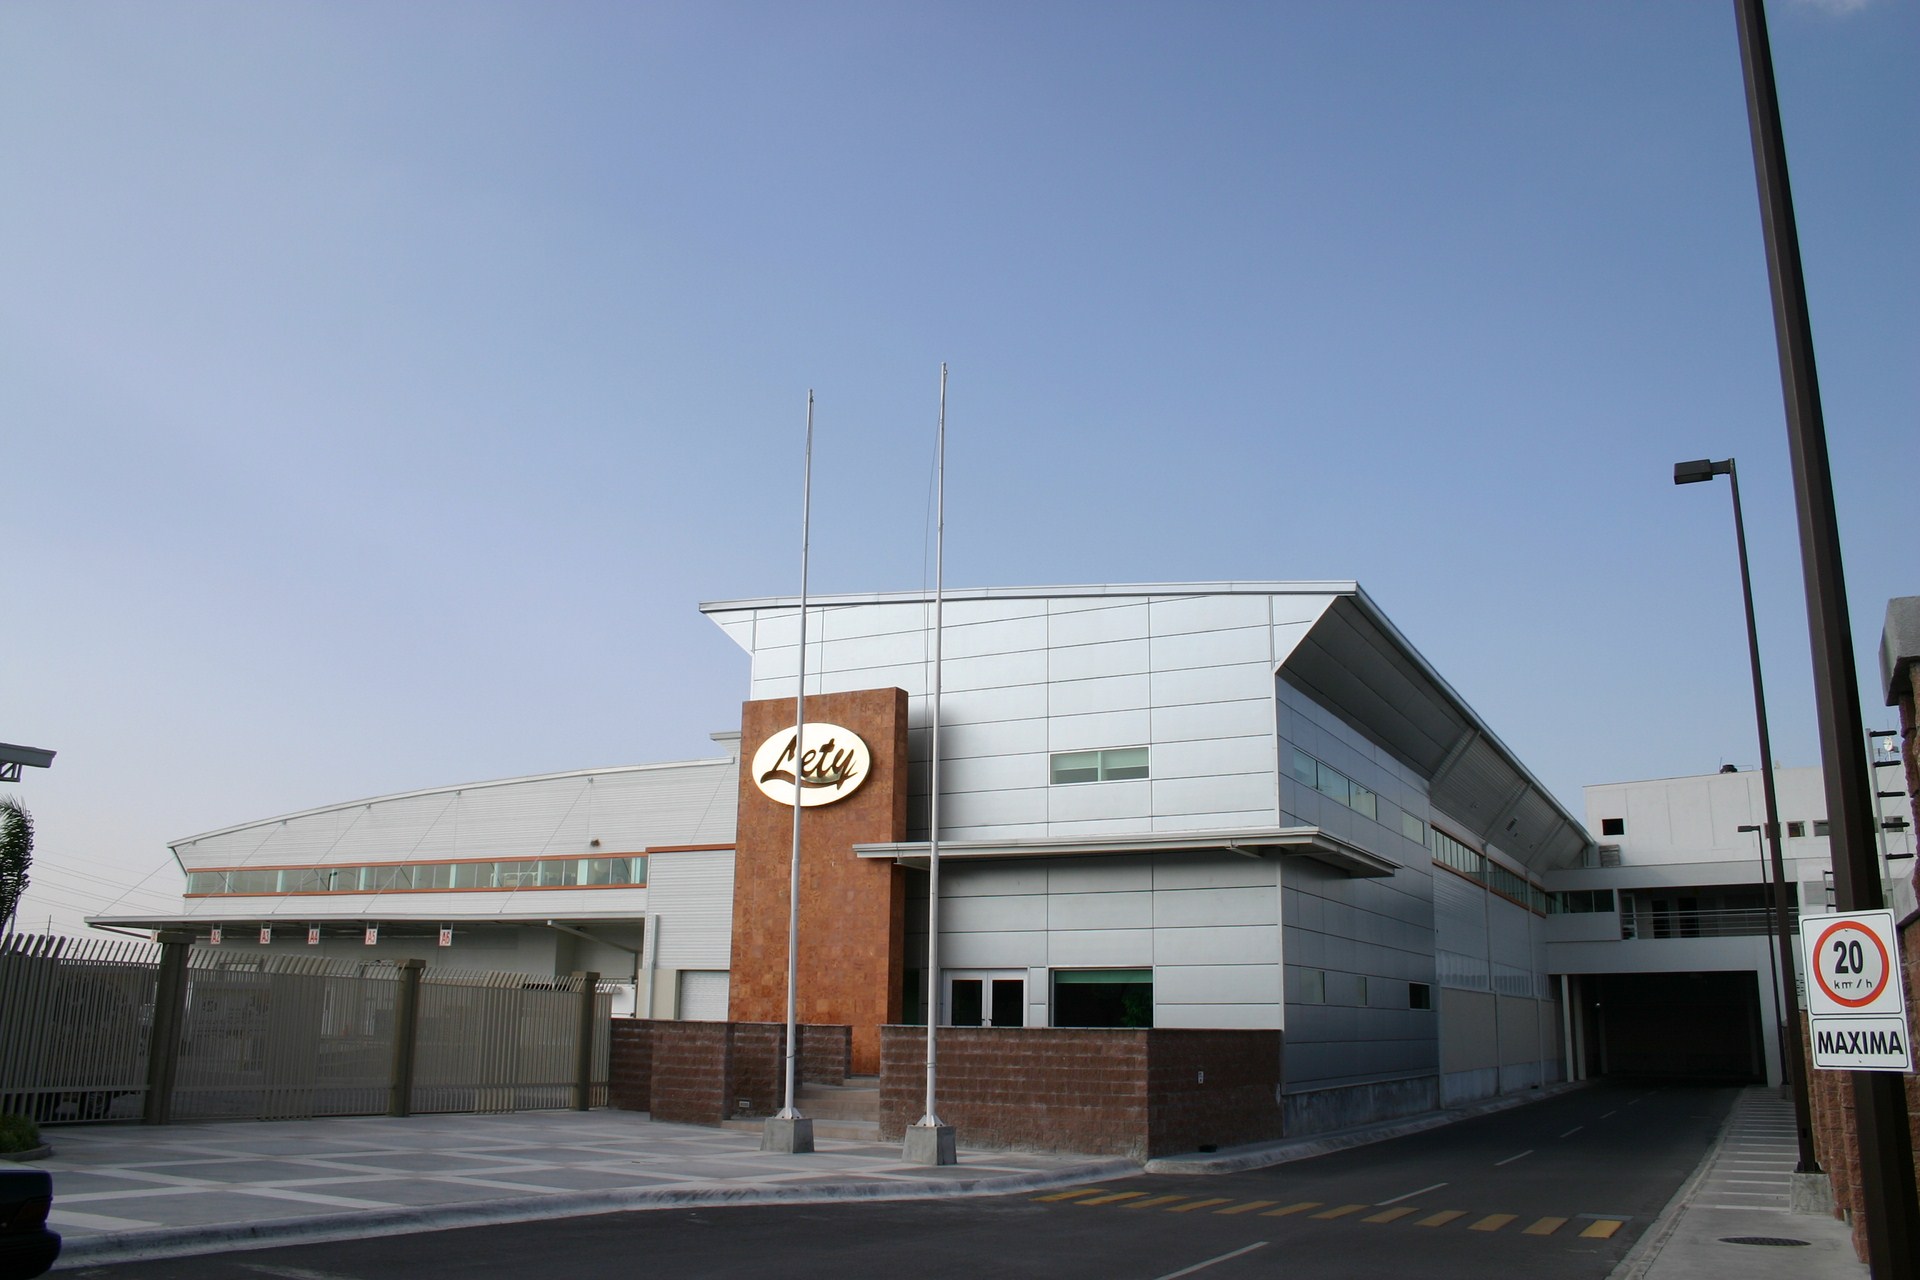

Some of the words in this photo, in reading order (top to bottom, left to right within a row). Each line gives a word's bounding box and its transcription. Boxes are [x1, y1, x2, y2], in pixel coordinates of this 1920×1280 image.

[760, 734, 858, 790] Lety
[211, 930, 220, 943] A2
[309, 930, 319, 943] A4
[366, 930, 376, 943] A5
[1833, 940, 1864, 974] 20
[1818, 1031, 1904, 1055] MAXIMA
